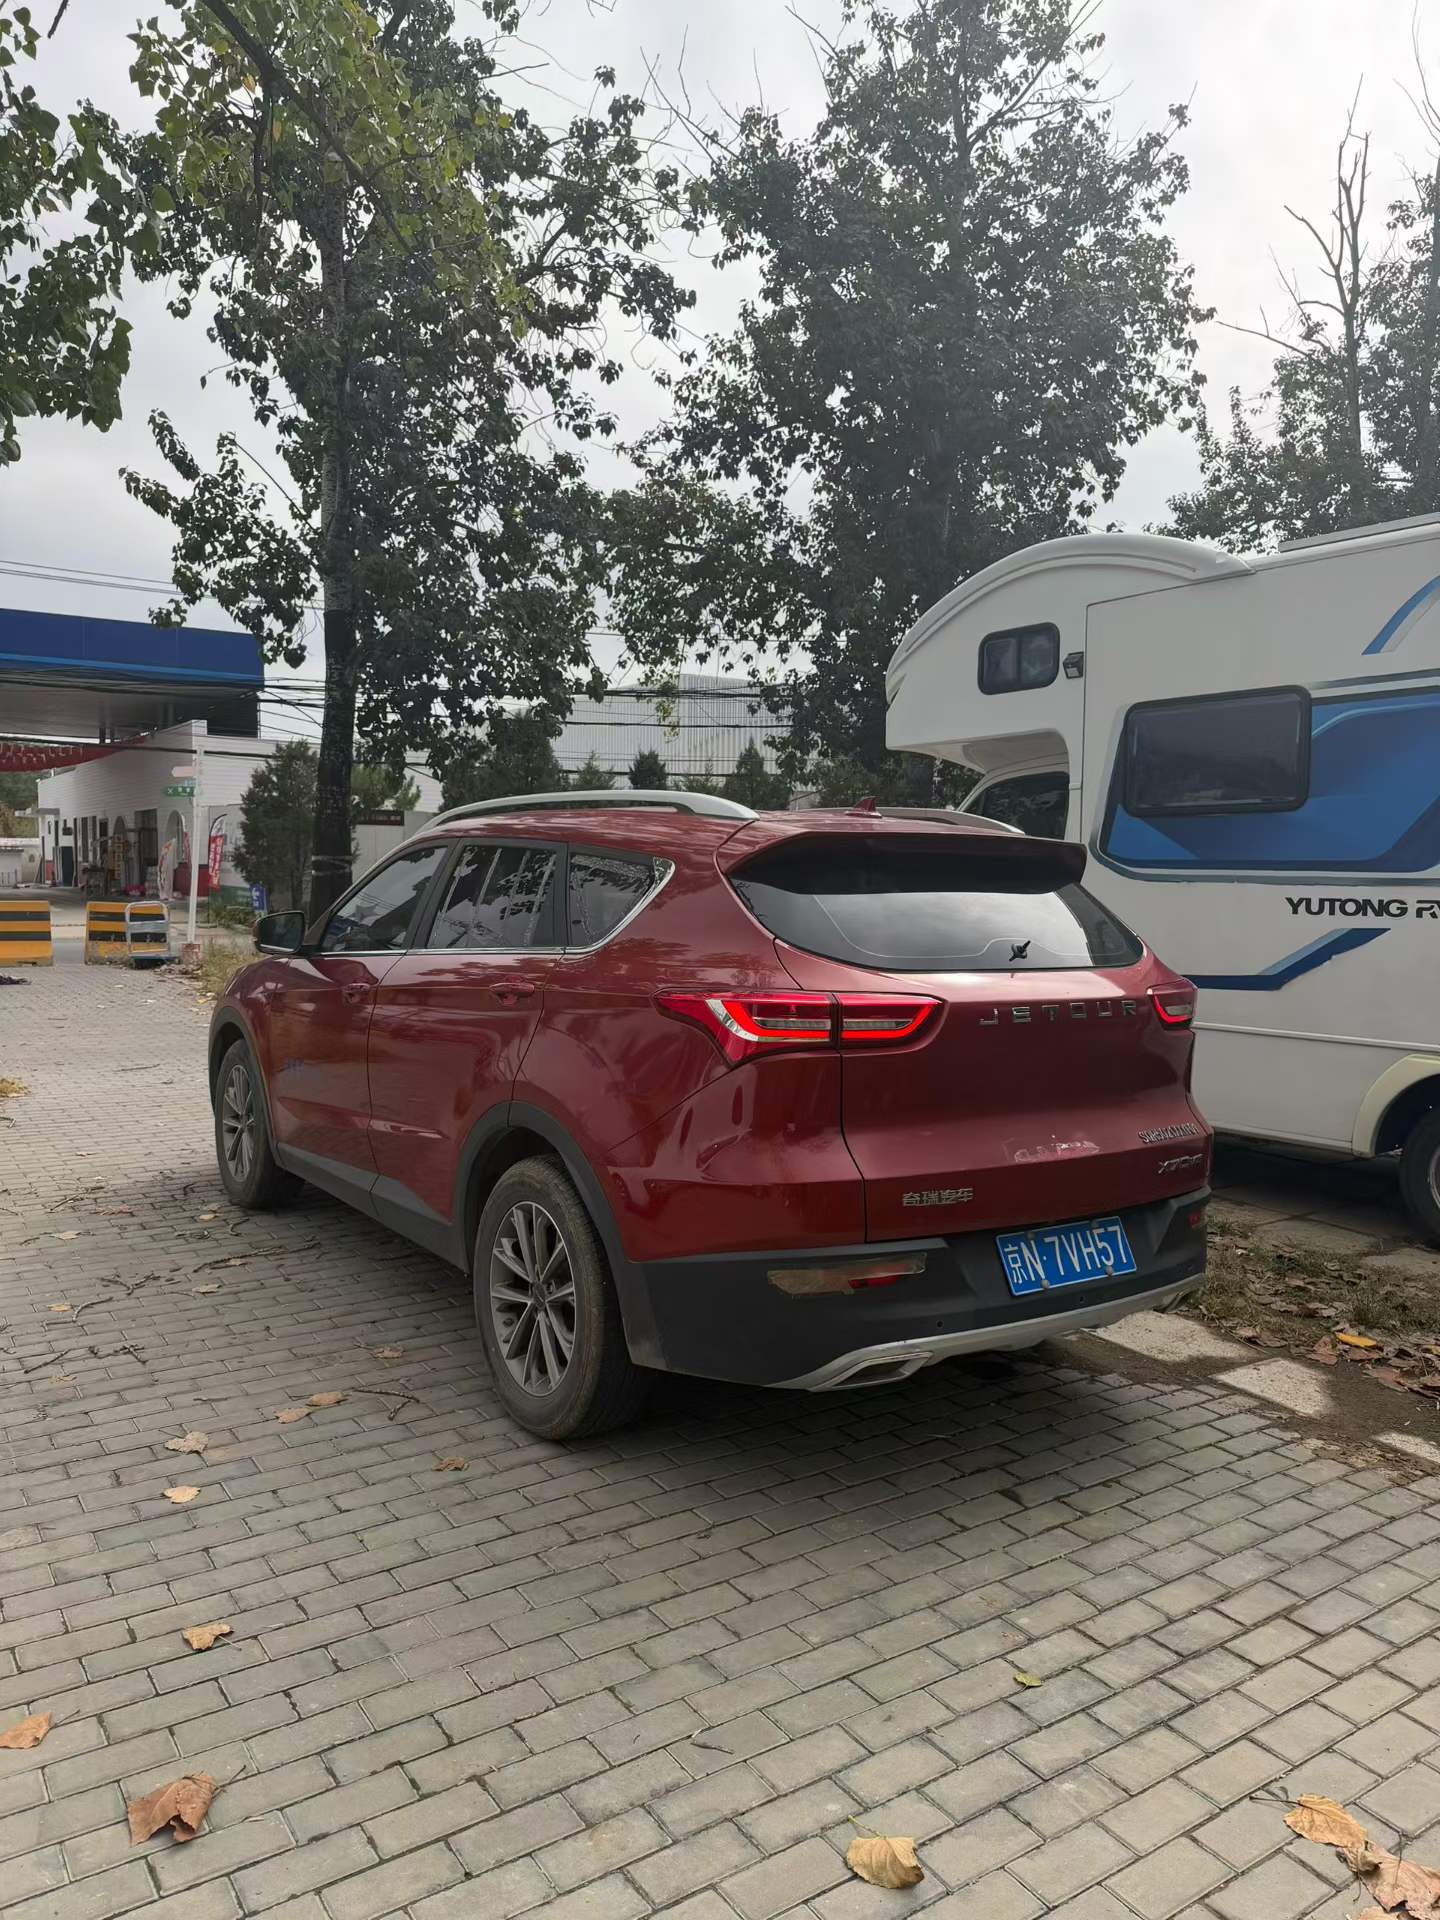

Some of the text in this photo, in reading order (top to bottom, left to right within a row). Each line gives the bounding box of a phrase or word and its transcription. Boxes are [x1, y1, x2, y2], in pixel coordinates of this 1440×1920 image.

[1285, 897, 1440, 918] YUTONG R
[979, 1000, 1137, 1025] JETOUR
[902, 1187, 974, 1207] 奇瑞汽车
